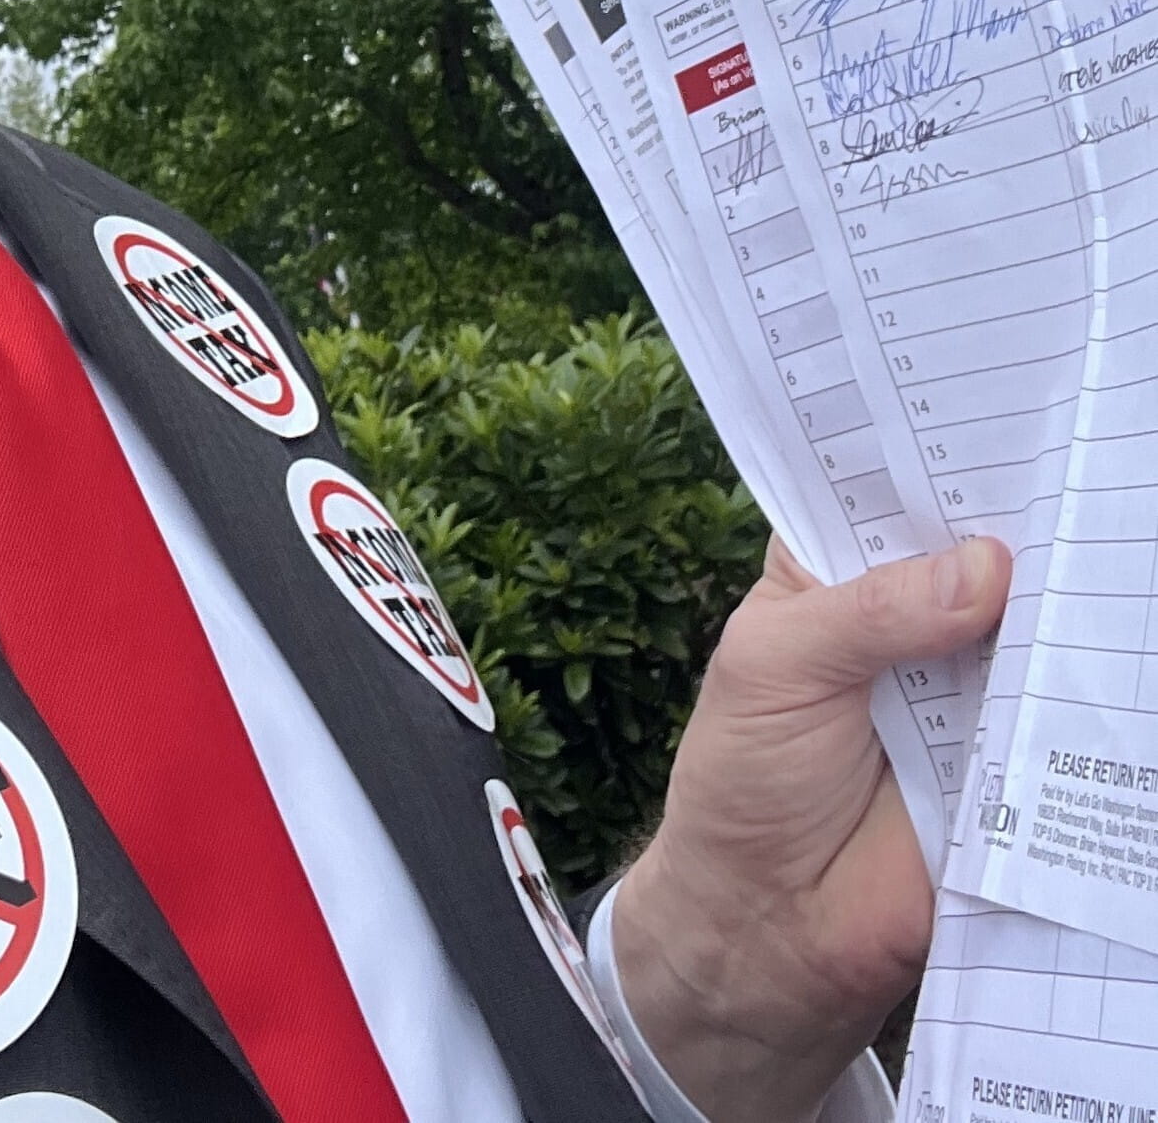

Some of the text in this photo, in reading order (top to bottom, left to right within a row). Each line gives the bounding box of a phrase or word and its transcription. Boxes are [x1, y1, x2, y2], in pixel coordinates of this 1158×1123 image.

[664, 2, 712, 33] WARNING:
[777, 14, 787, 29] 5
[792, 55, 802, 70] 6
[805, 97, 814, 113] 7
[713, 106, 766, 134] Brian
[819, 140, 830, 155] 8
[834, 182, 844, 197] 9
[724, 206, 735, 220] 2
[848, 224, 867, 240] 10
[740, 246, 750, 261] 3
[863, 267, 880, 285] 11
[123, 265, 238, 334] INCOME
[756, 287, 765, 301] 4
[877, 311, 897, 327] 12
[770, 329, 780, 344] 5
[186, 325, 280, 388] TAX
[893, 355, 913, 372] 13
[786, 371, 797, 386] 6
[910, 399, 930, 417] 14
[803, 412, 813, 428] 7
[926, 444, 947, 462] 15
[823, 454, 836, 469] 8
[845, 495, 856, 510] 9
[943, 489, 963, 506] 16
[865, 535, 884, 553] 10
[906, 670, 929, 687] 13
[925, 714, 945, 731] 14
[940, 761, 955, 778] 15
[1047, 750, 1092, 780] PLEASE
[1092, 758, 1137, 789] RETURN
[973, 1076, 1012, 1108] PLEASE
[1012, 1085, 1055, 1116] RETURN
[1055, 1091, 1105, 1123] PETITION
[1108, 1102, 1124, 1123] BY
